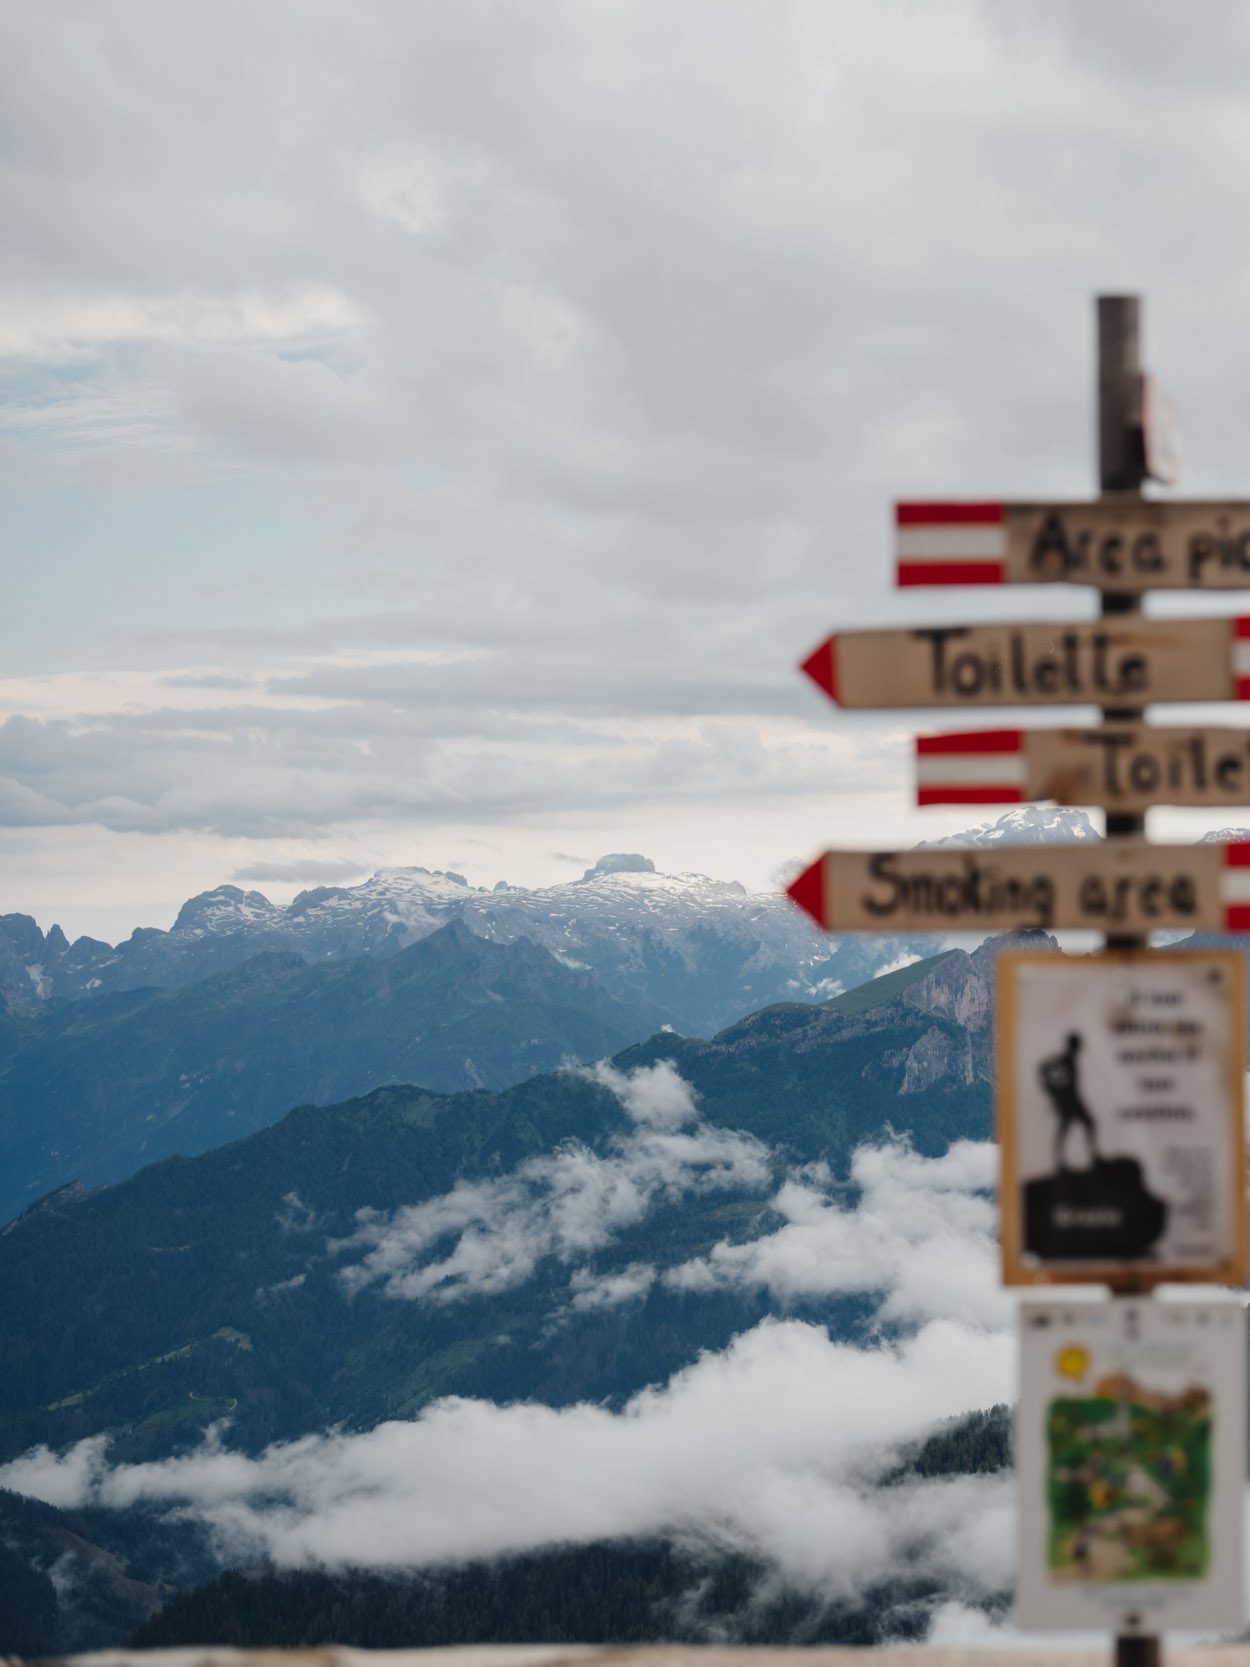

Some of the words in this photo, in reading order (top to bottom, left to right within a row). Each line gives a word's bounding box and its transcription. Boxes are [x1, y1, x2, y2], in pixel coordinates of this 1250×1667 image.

[1029, 511, 1166, 574] Area
[913, 627, 1148, 697] Toilette
[861, 853, 1056, 929] Smoking
[1079, 872, 1198, 921] area
